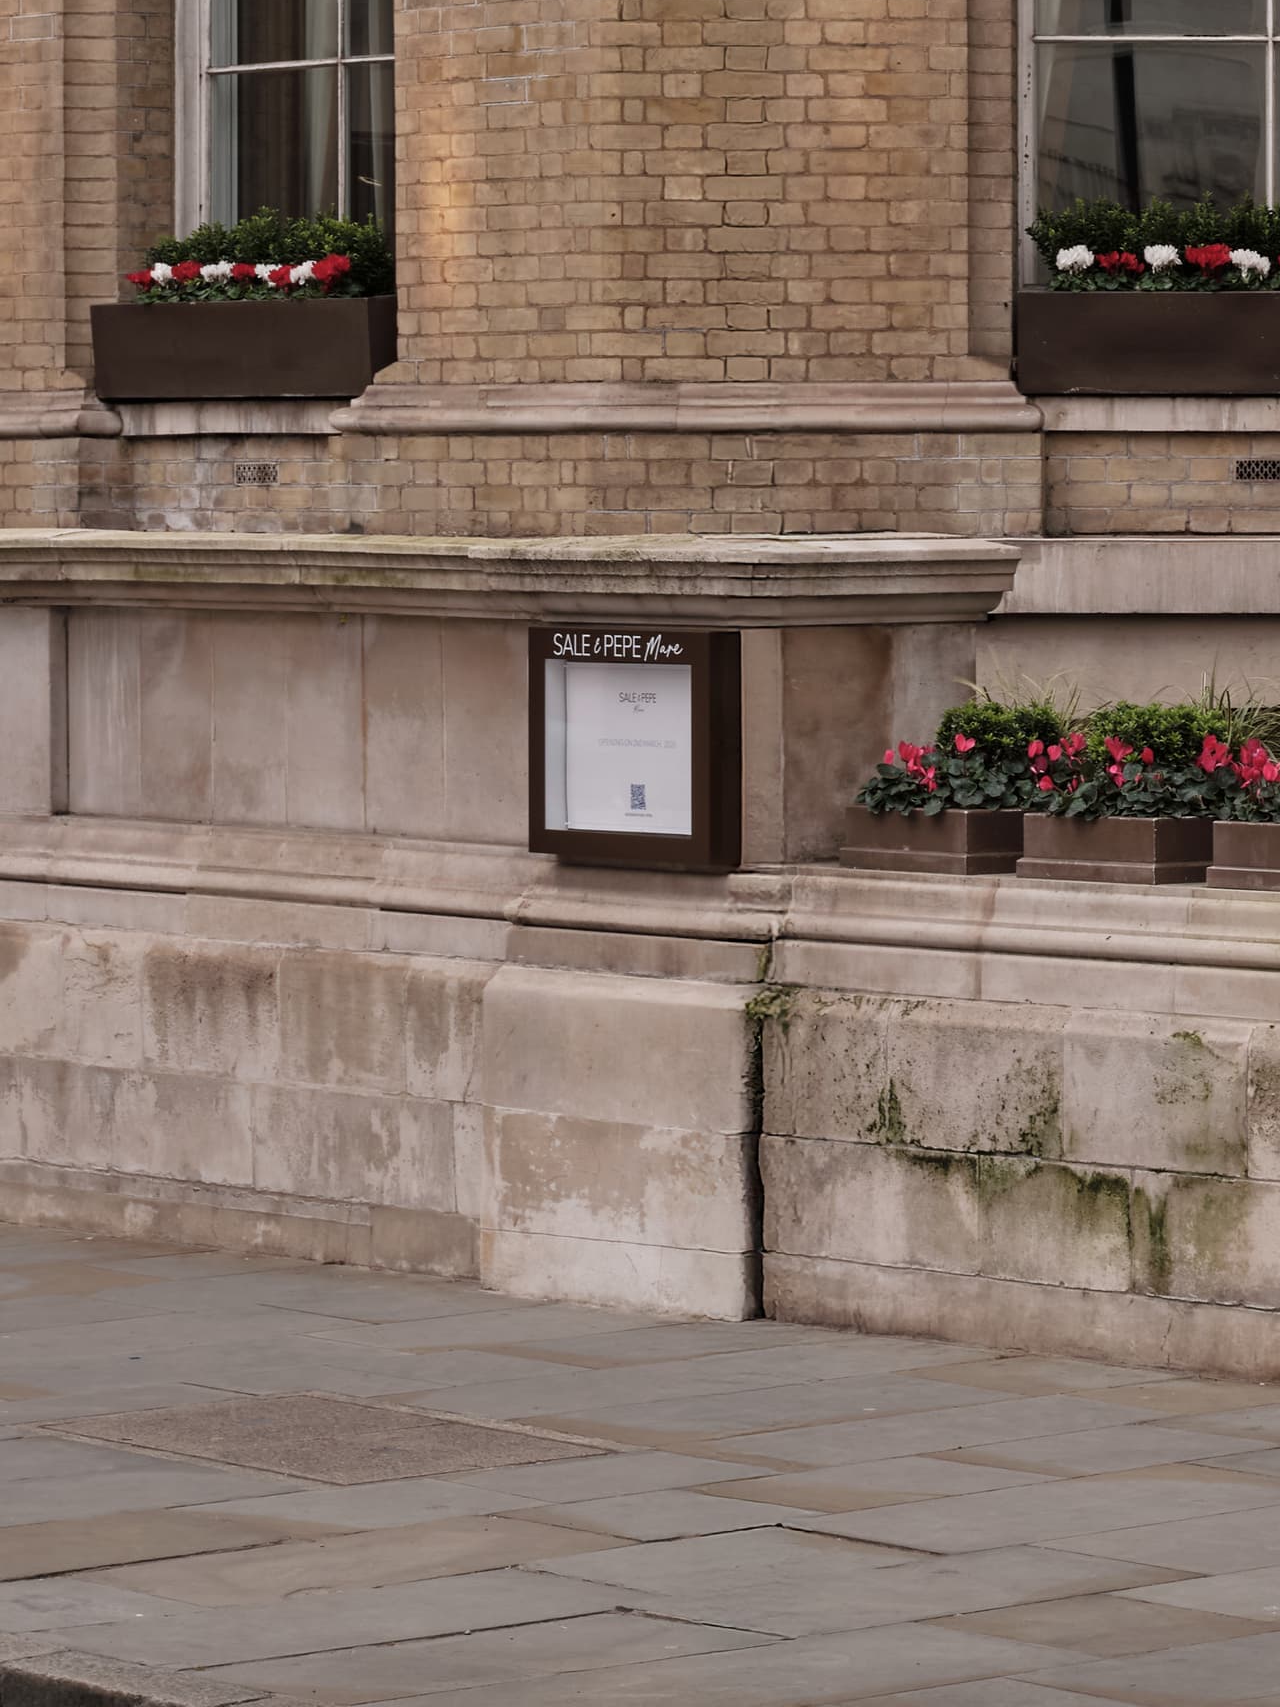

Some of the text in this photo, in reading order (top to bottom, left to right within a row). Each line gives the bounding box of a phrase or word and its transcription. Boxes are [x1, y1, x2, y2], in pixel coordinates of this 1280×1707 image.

[553, 633, 591, 656] SALE
[603, 634, 642, 658] PEPE
[643, 634, 684, 662] Mare
